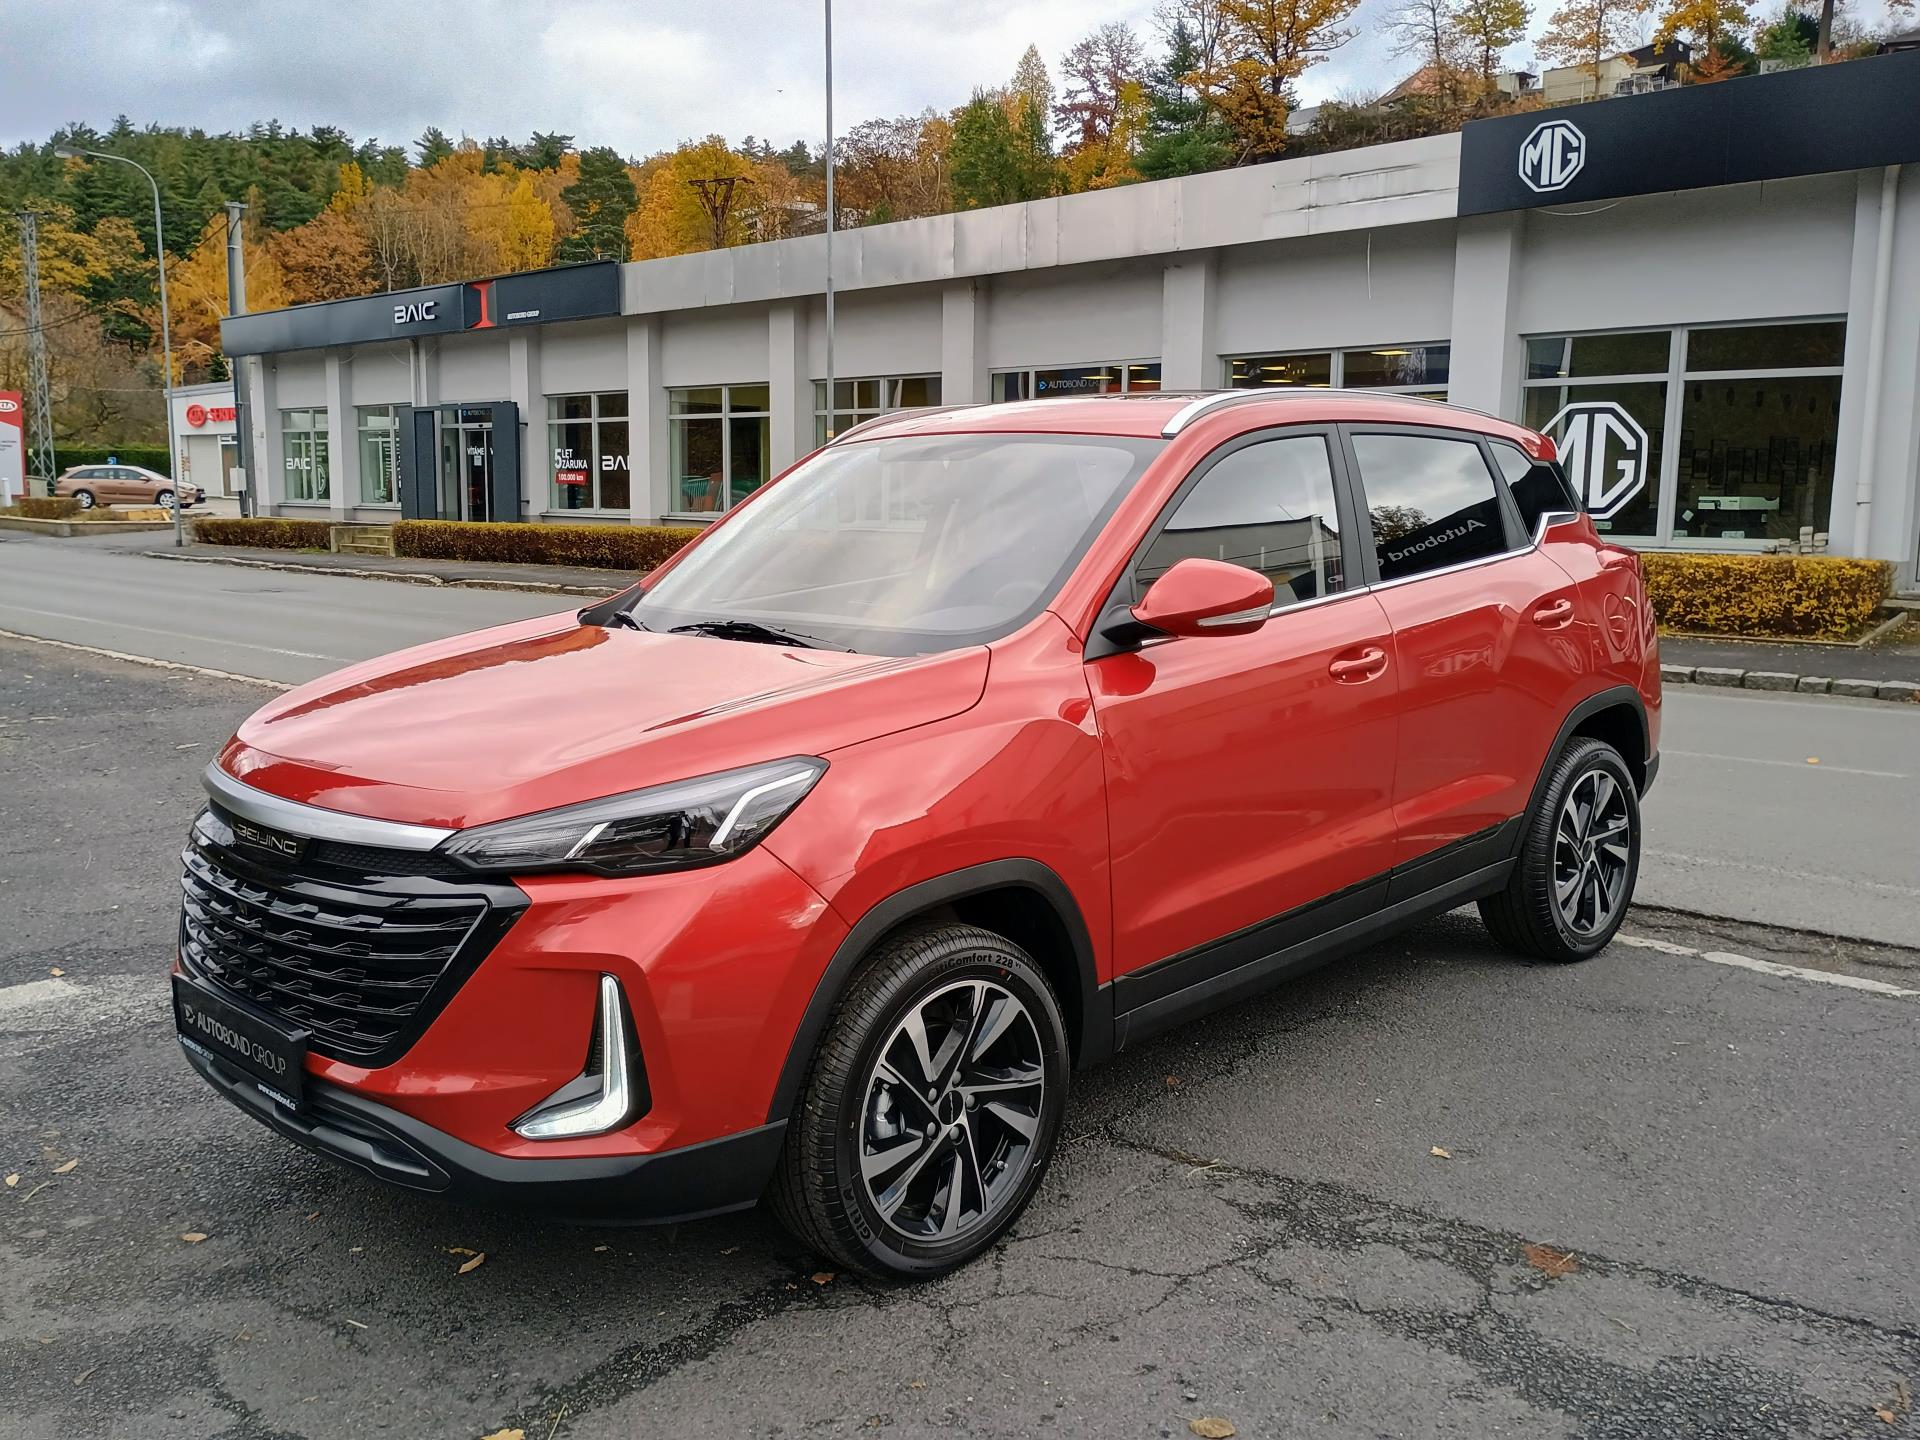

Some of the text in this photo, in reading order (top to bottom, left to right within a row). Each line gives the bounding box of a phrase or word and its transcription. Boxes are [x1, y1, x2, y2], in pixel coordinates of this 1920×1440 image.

[1523, 124, 1581, 188] MG
[393, 301, 435, 324] BAIC
[1048, 379, 1087, 390] AUTOBOND
[285, 457, 311, 470] BAIC
[554, 448, 573, 469] 5 LET
[1556, 412, 1637, 509] MG
[996, 954, 1013, 968] 228
[197, 1011, 286, 1076] AUTOBOND GROUP
